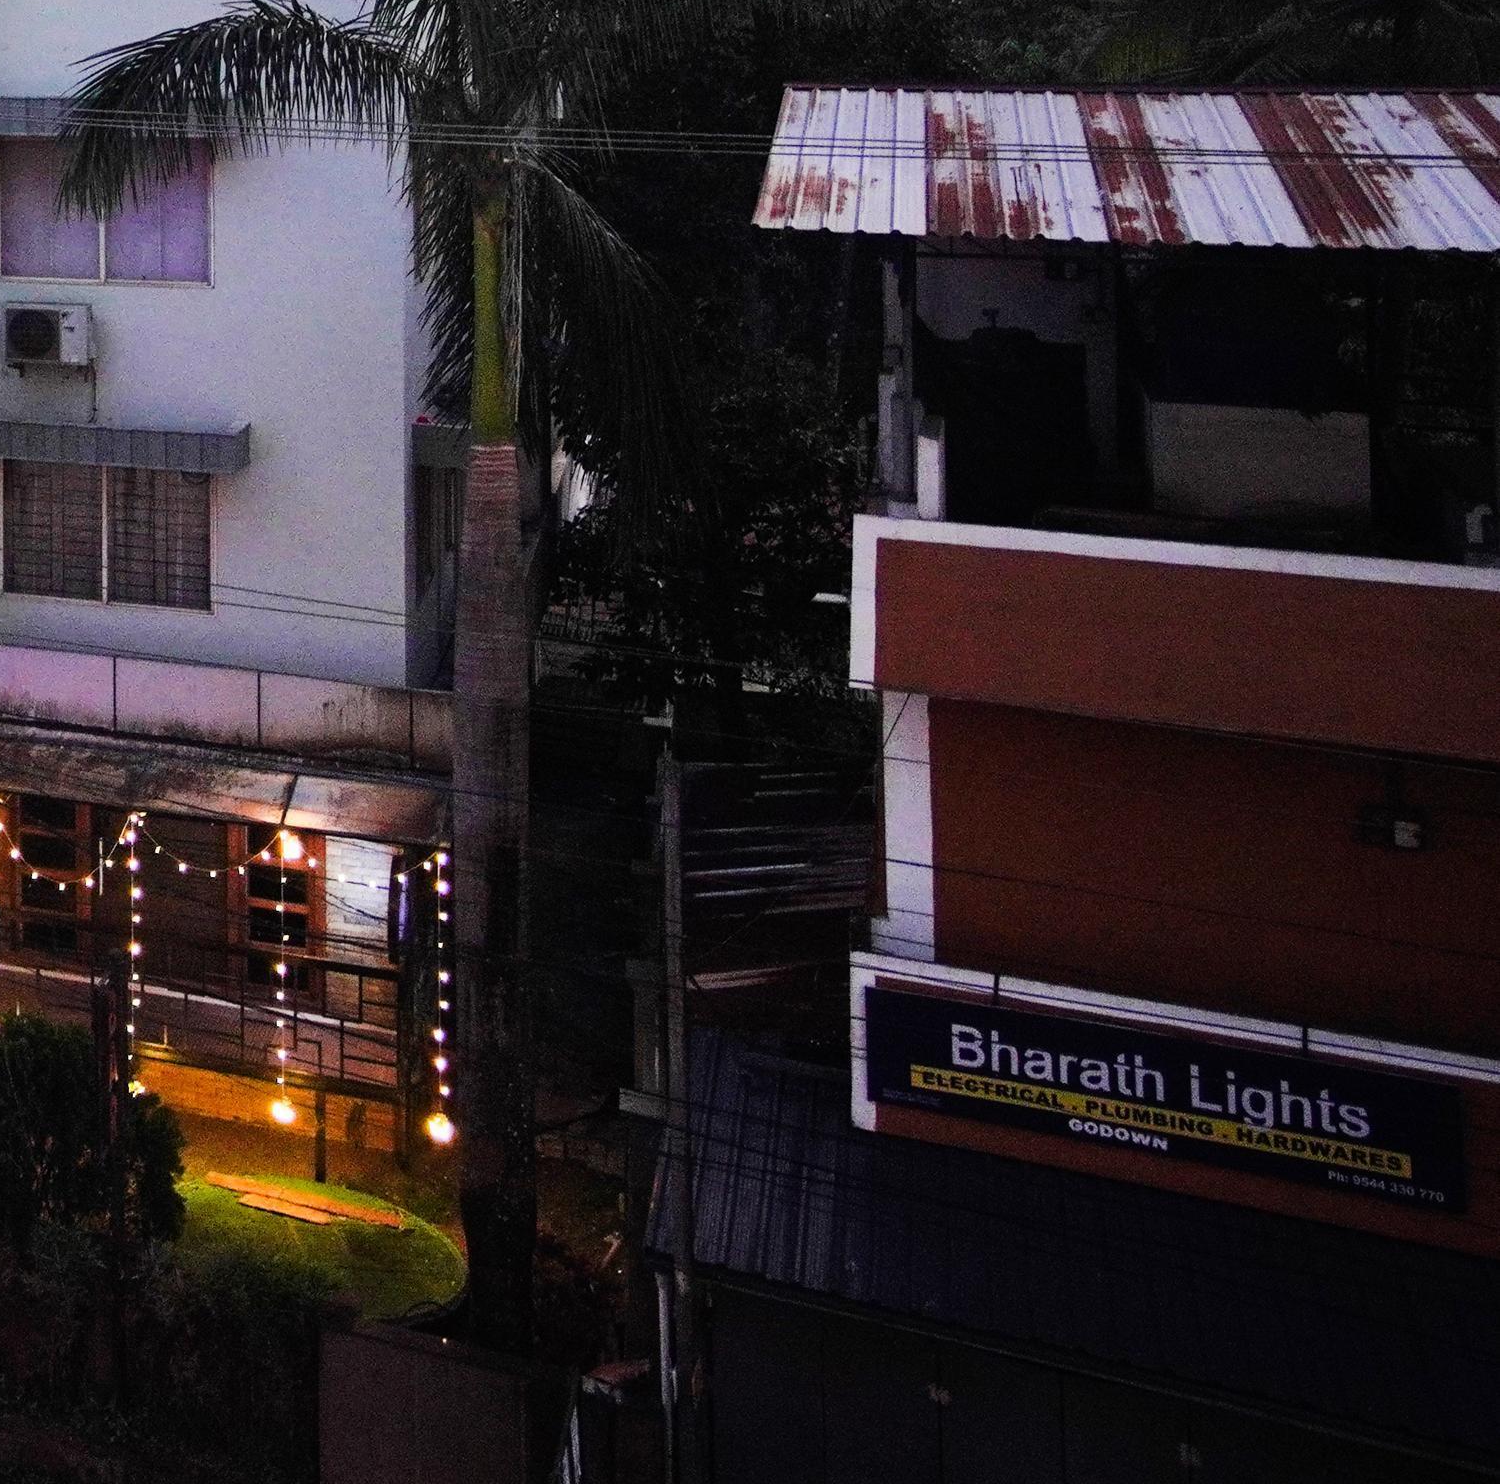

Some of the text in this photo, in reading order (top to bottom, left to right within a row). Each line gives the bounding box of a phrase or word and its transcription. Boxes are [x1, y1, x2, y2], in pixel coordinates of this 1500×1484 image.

[922, 1072, 1065, 1110] ELECTRICAL
[1085, 1100, 1214, 1136] PLUMBING
[1236, 1127, 1402, 1171] HARDWARES
[951, 1024, 1370, 1138] Bharath Lights
[1068, 1118, 1168, 1151] GODOWN
